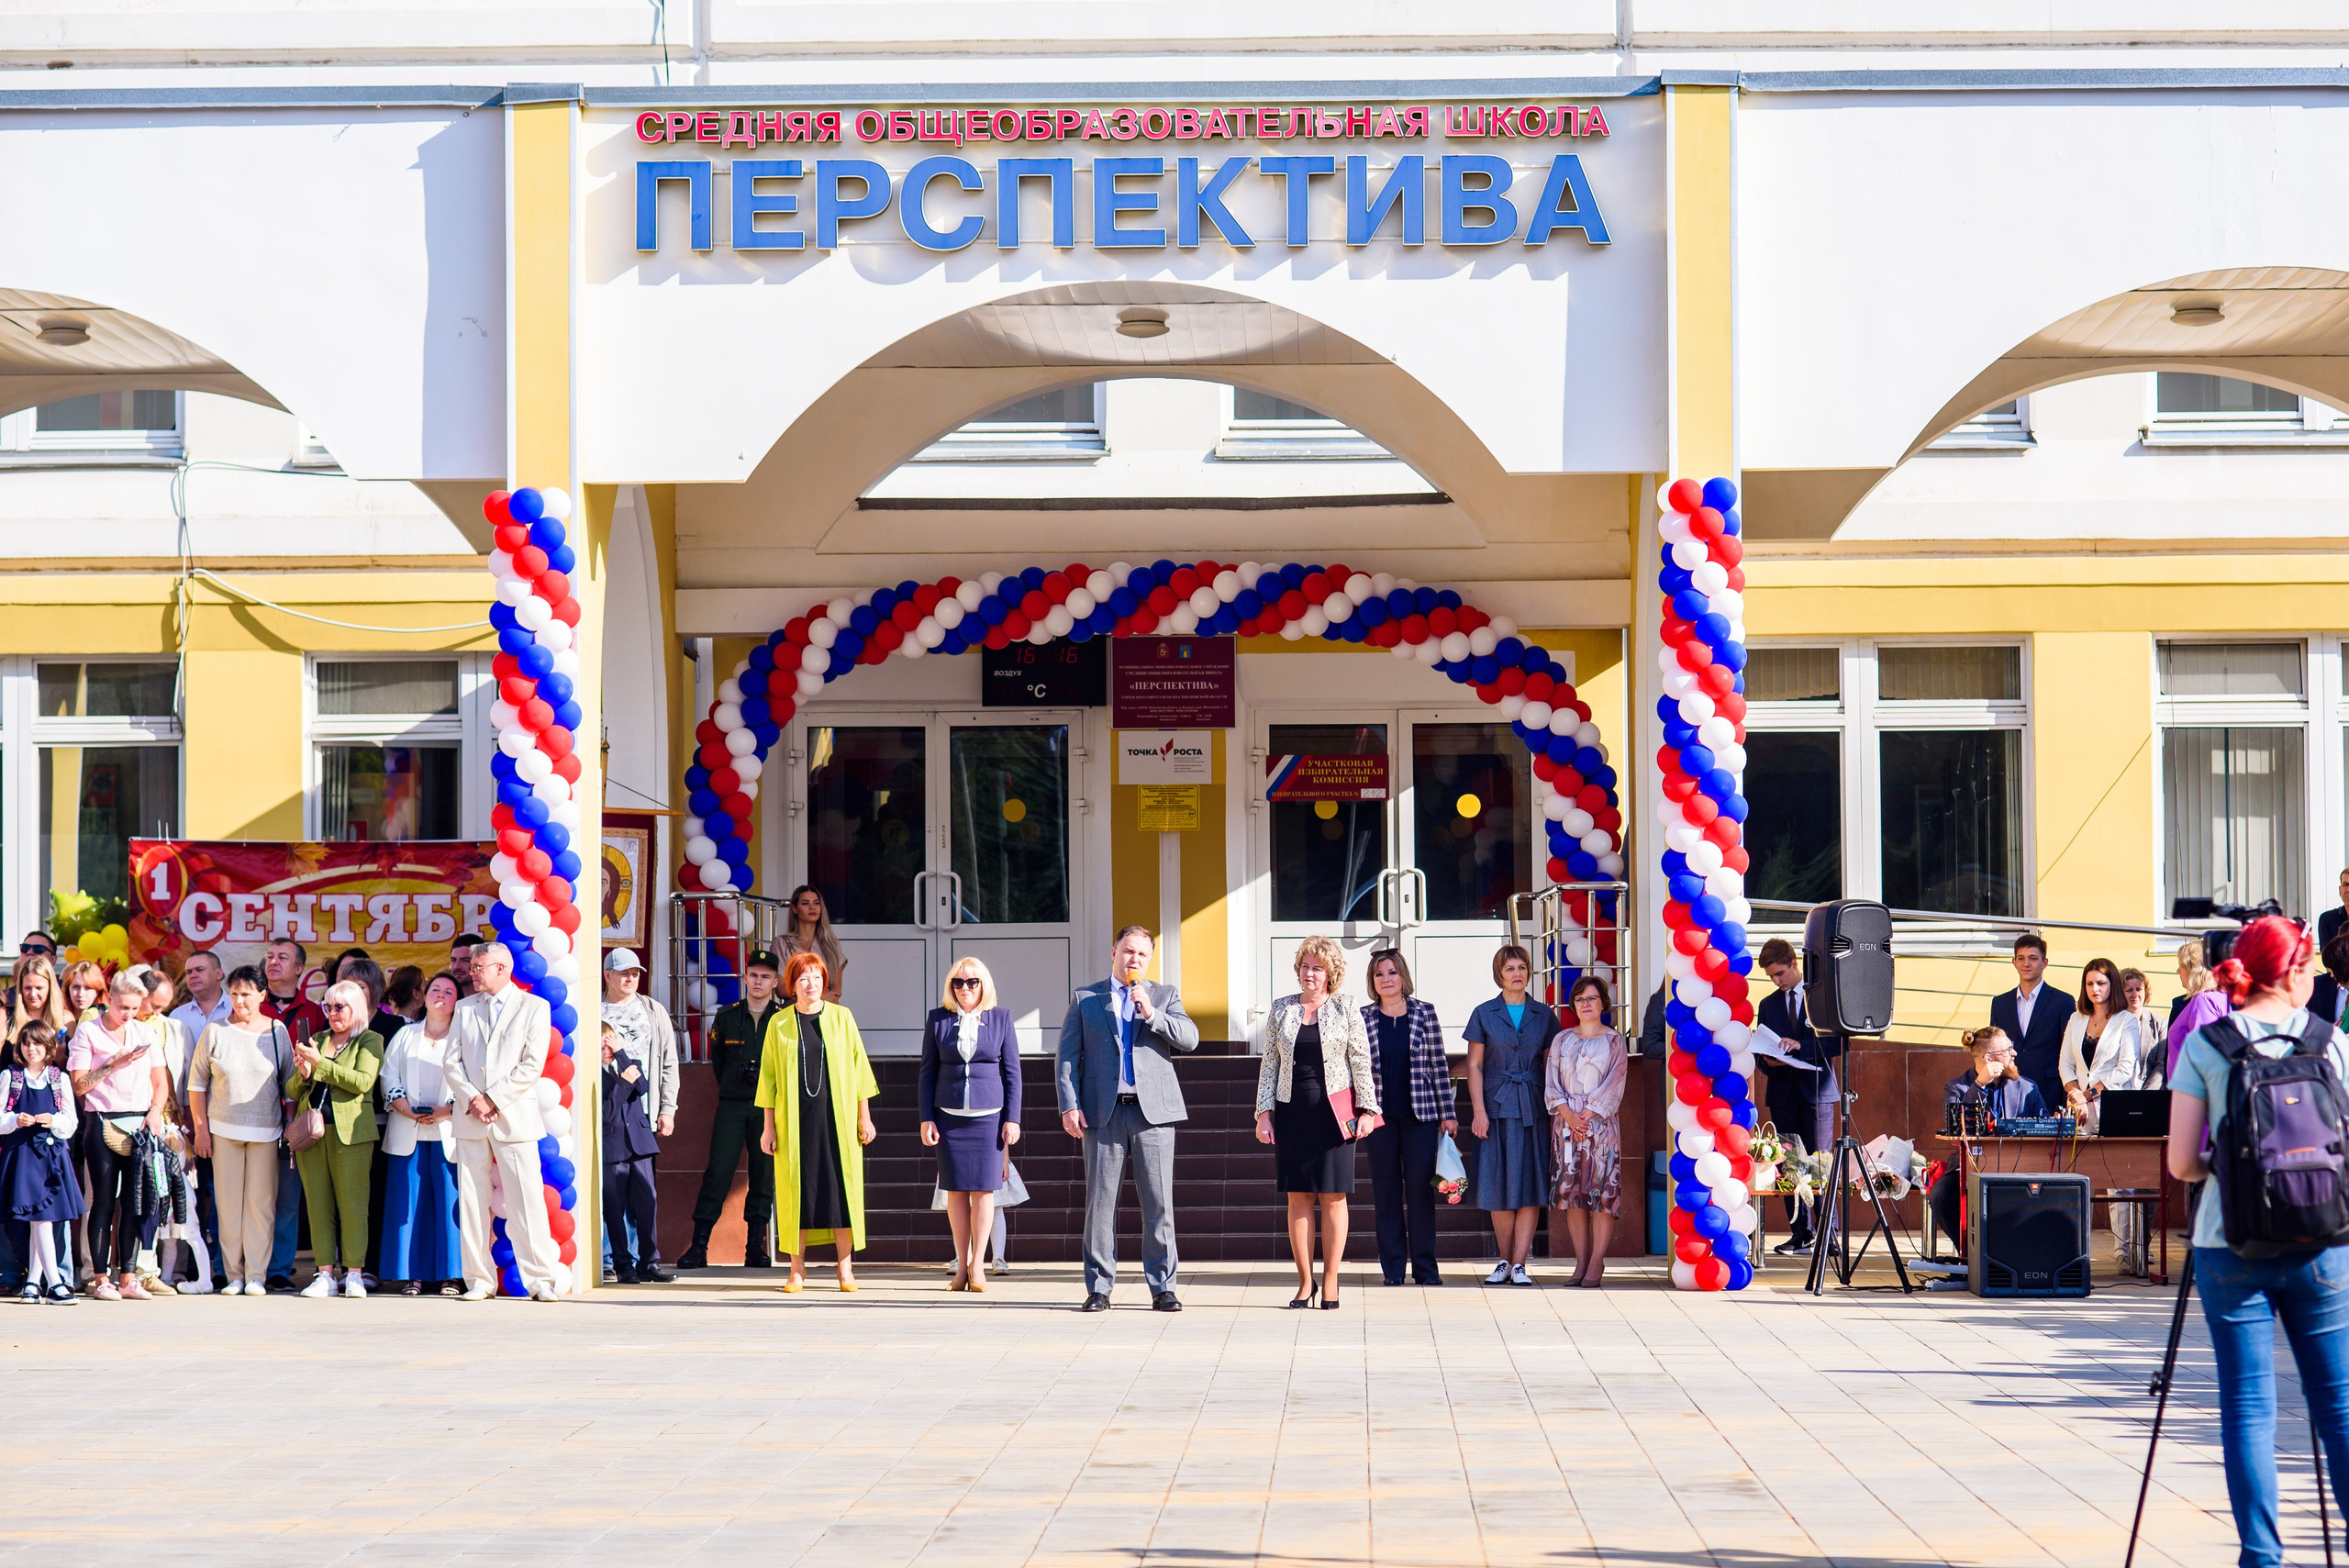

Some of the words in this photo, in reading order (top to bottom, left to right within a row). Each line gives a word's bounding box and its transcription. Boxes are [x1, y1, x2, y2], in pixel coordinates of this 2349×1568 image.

[636, 110, 842, 149] СРЕДНЯЯ
[854, 106, 1430, 147] ОБЩЕОБРАЗОВАТЕЛЬНАЯ
[1445, 105, 1611, 138] ШКОЛА
[635, 153, 1612, 251] ПЕРСПЕКТИВА
[1130, 682, 1219, 690] «ПЕРСПЕКТИВА»
[1174, 748, 1203, 756] РОСТА
[1297, 768, 1384, 776] ИЗБИРАТЕЛЬНАЯ
[150, 862, 171, 900] 1
[178, 892, 500, 944] СЕНТЯБР
[1859, 942, 1876, 951] EON
